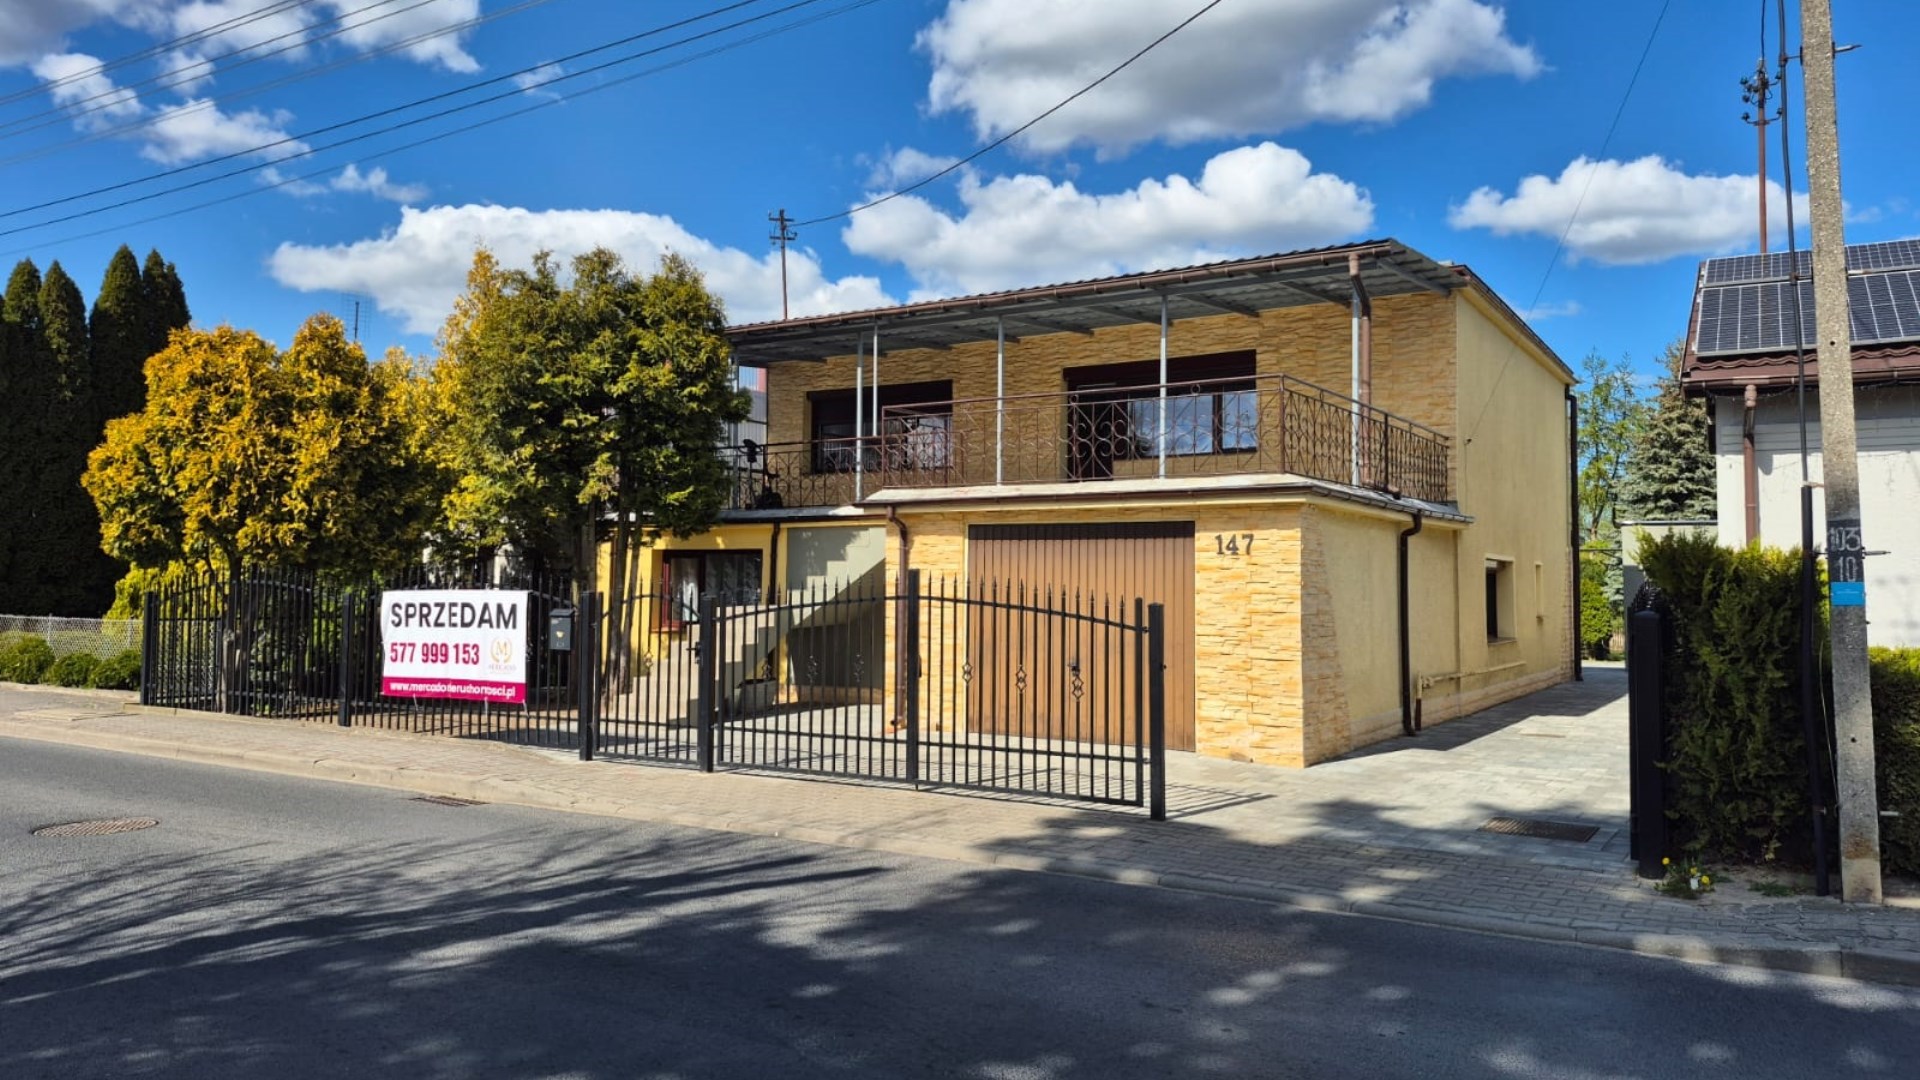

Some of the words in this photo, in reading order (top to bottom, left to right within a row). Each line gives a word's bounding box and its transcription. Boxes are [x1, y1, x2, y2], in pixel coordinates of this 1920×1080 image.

[1215, 533, 1254, 555] 147
[391, 602, 517, 629] SPRZEDAM
[390, 642, 416, 663] 577
[421, 642, 448, 664] 999
[453, 642, 479, 665] 153
